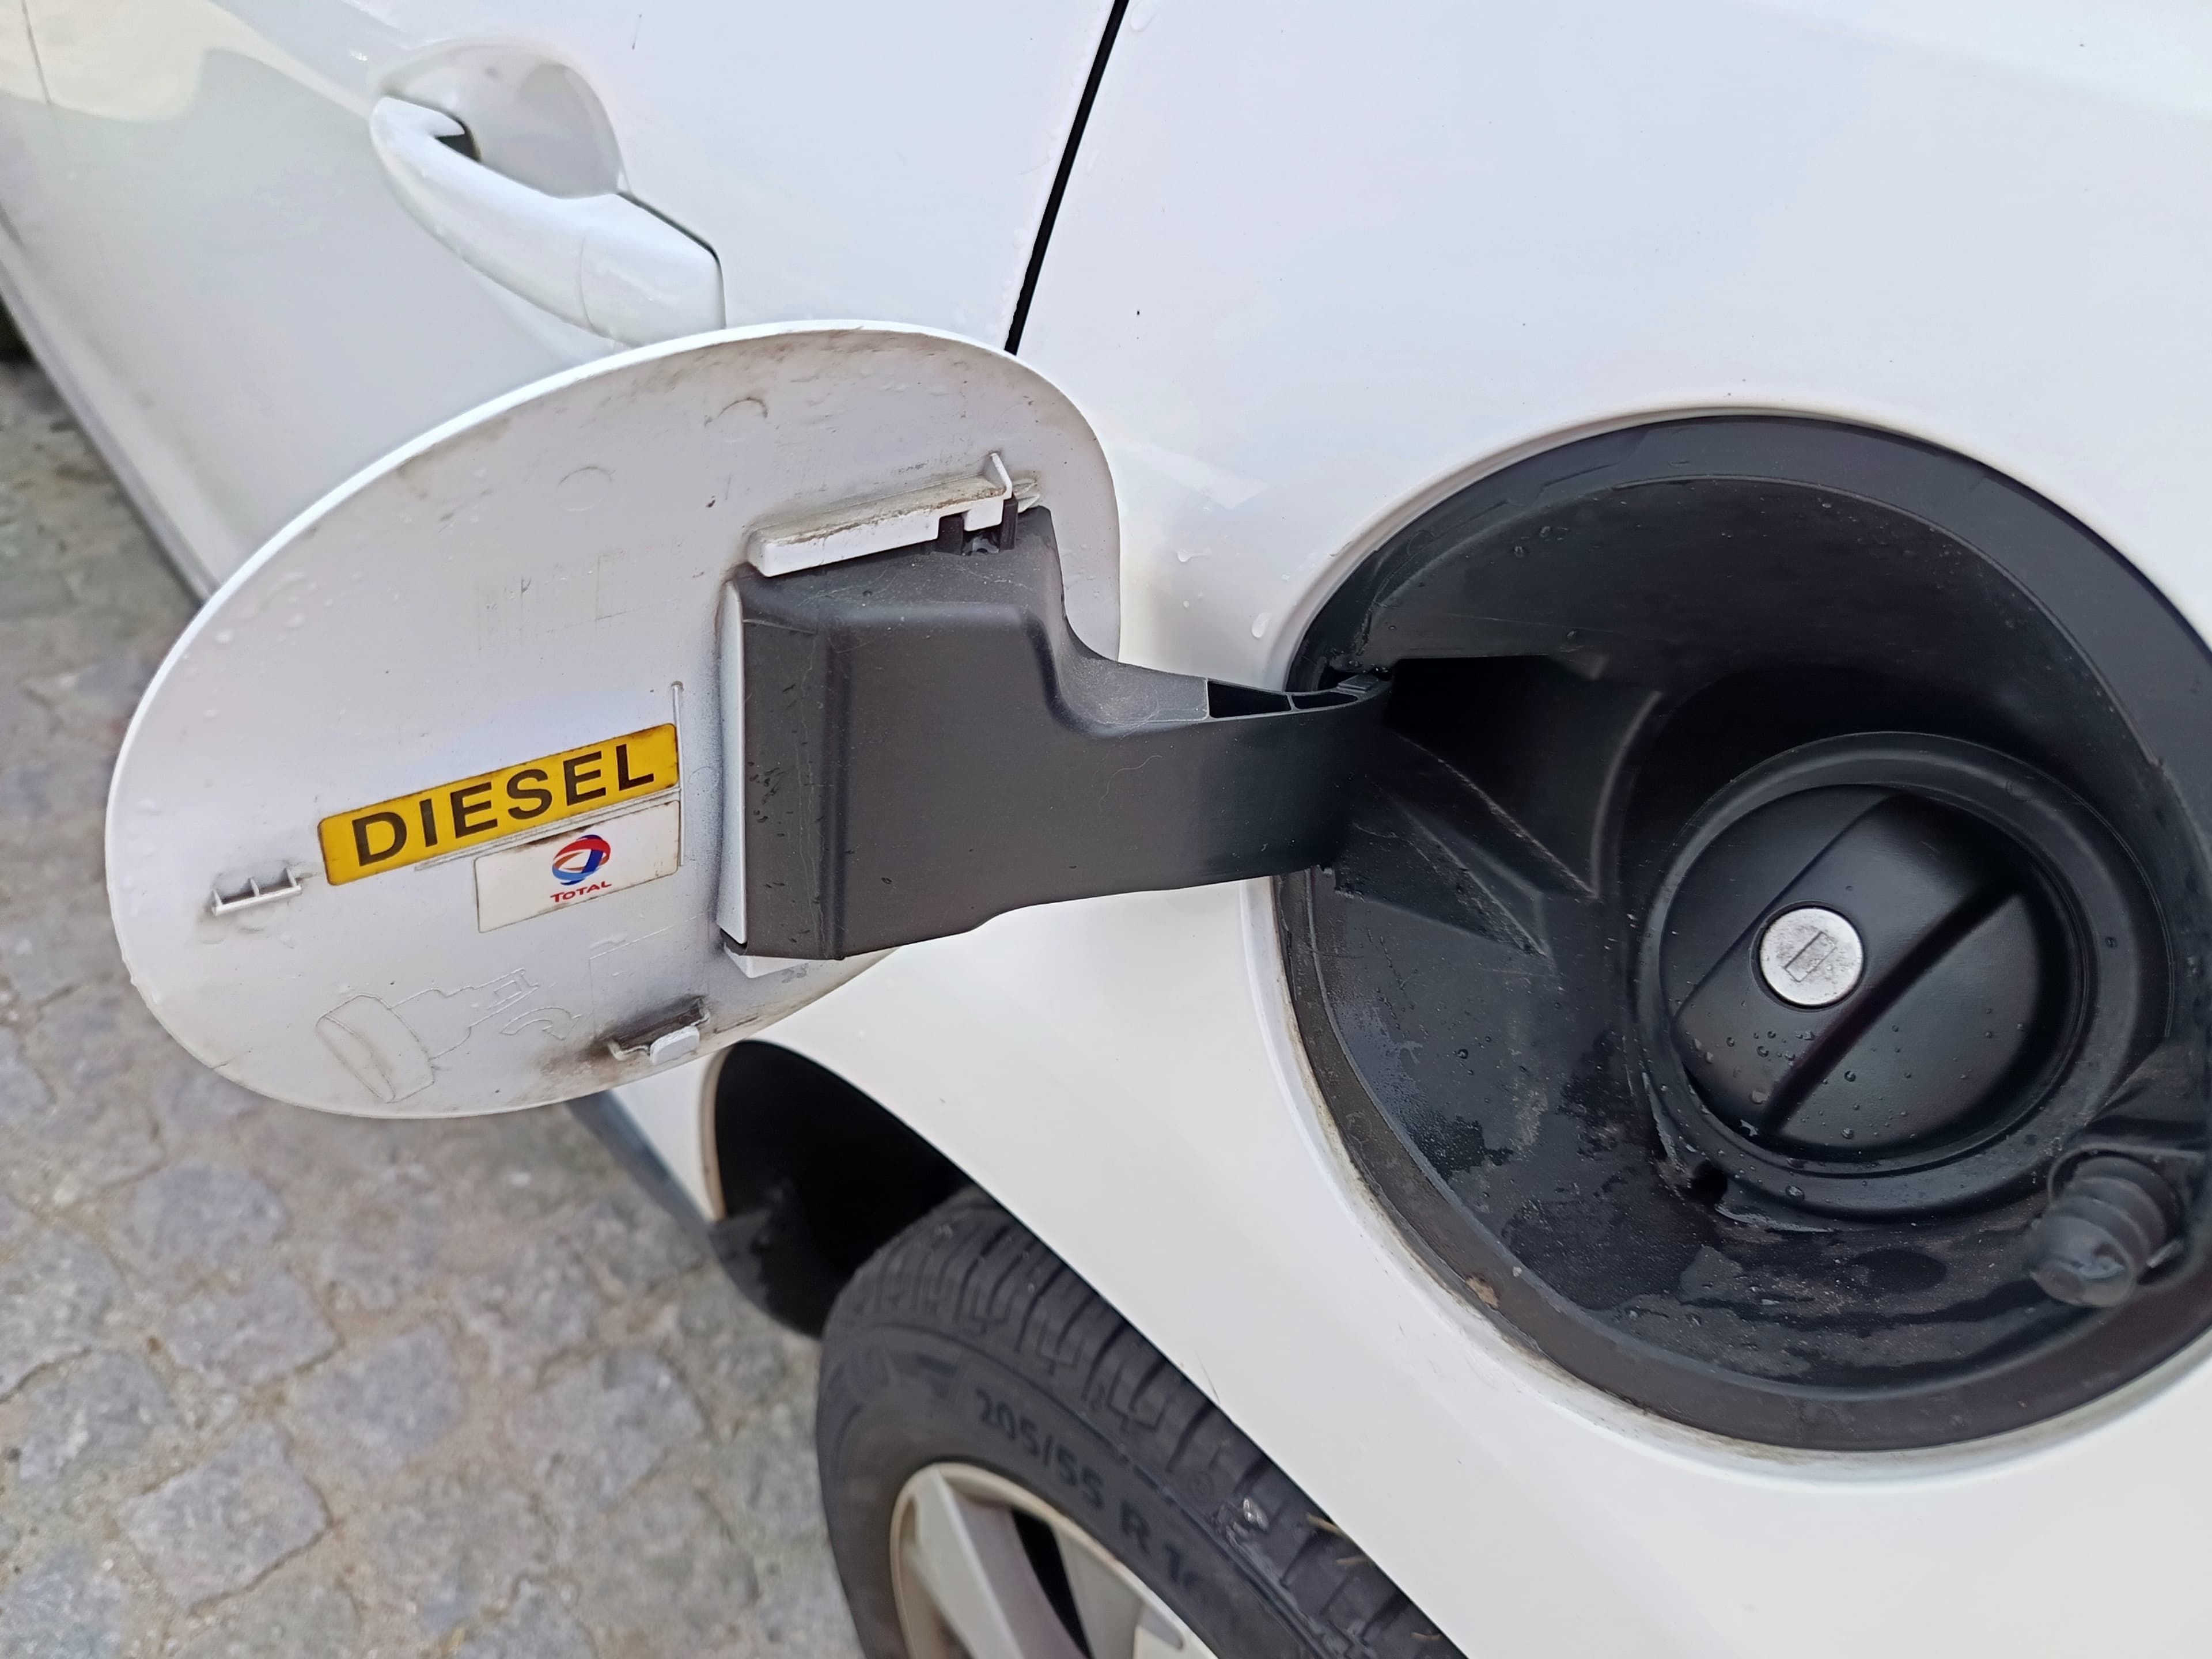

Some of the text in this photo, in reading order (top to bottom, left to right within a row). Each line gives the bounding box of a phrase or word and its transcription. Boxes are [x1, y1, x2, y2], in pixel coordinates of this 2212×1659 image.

[352, 744, 654, 866] DIESEL
[550, 881, 612, 903] TOTAL
[975, 1387, 1105, 1510] 205/55
[1120, 1499, 1150, 1556] R
